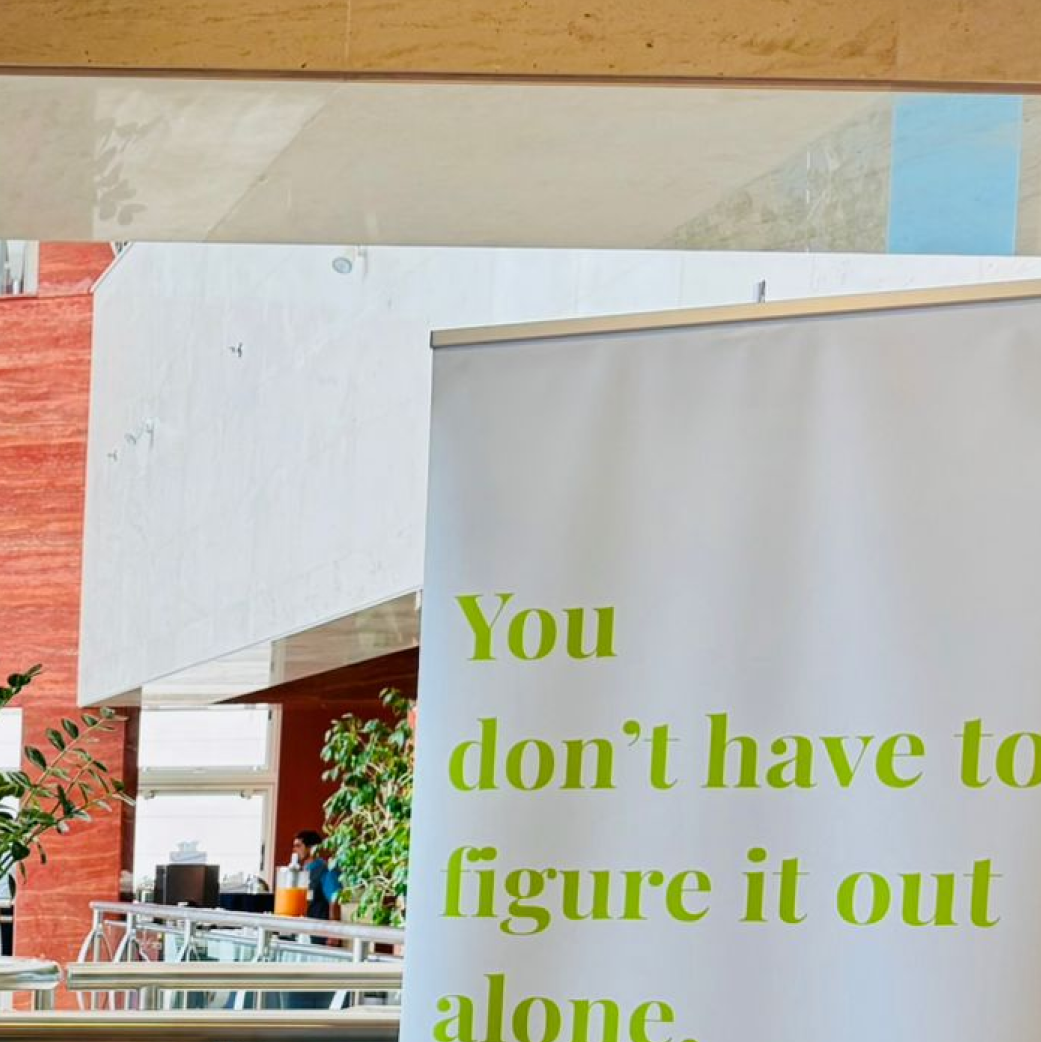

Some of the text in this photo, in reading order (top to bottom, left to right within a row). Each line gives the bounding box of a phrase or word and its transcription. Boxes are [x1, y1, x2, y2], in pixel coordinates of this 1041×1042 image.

[455, 593, 617, 662] You
[448, 713, 1041, 791] don’t have to
[439, 846, 1003, 936] figure it out
